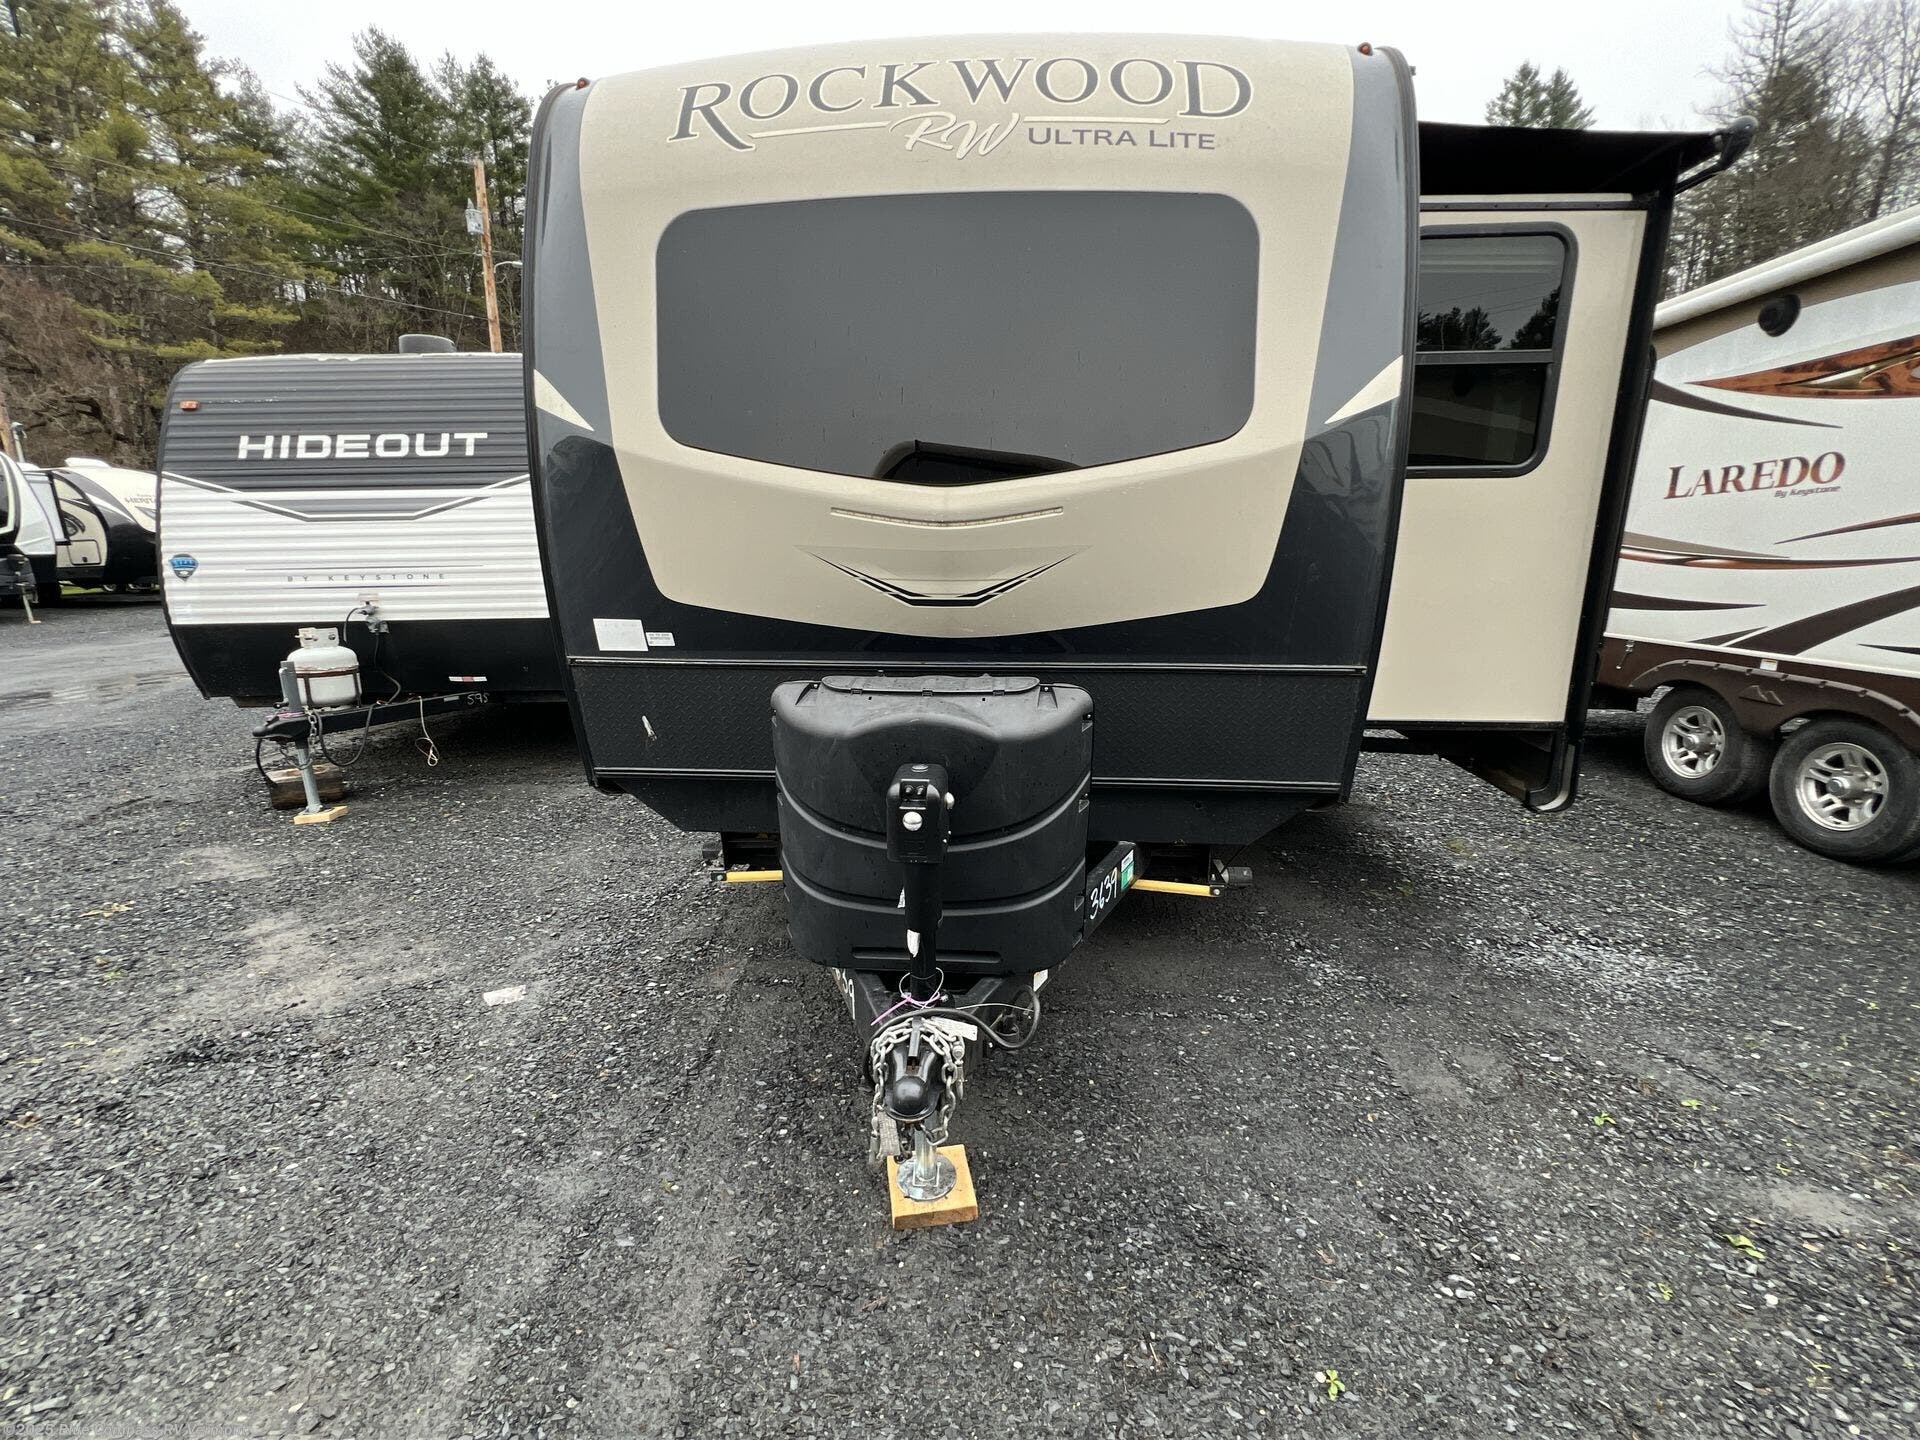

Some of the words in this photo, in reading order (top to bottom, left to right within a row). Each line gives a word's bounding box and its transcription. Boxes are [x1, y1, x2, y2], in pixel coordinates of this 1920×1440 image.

[666, 56, 1253, 151] ROCKWOOD
[889, 111, 1021, 160] RW
[1027, 126, 1138, 147] ULTRA
[1149, 129, 1217, 150] LITE
[237, 432, 488, 460] HIDEOUT
[1664, 451, 1846, 500] LAREDO
[287, 575, 309, 583] BY
[328, 573, 446, 582] KEYSTONE
[1089, 866, 1119, 920] 3639
